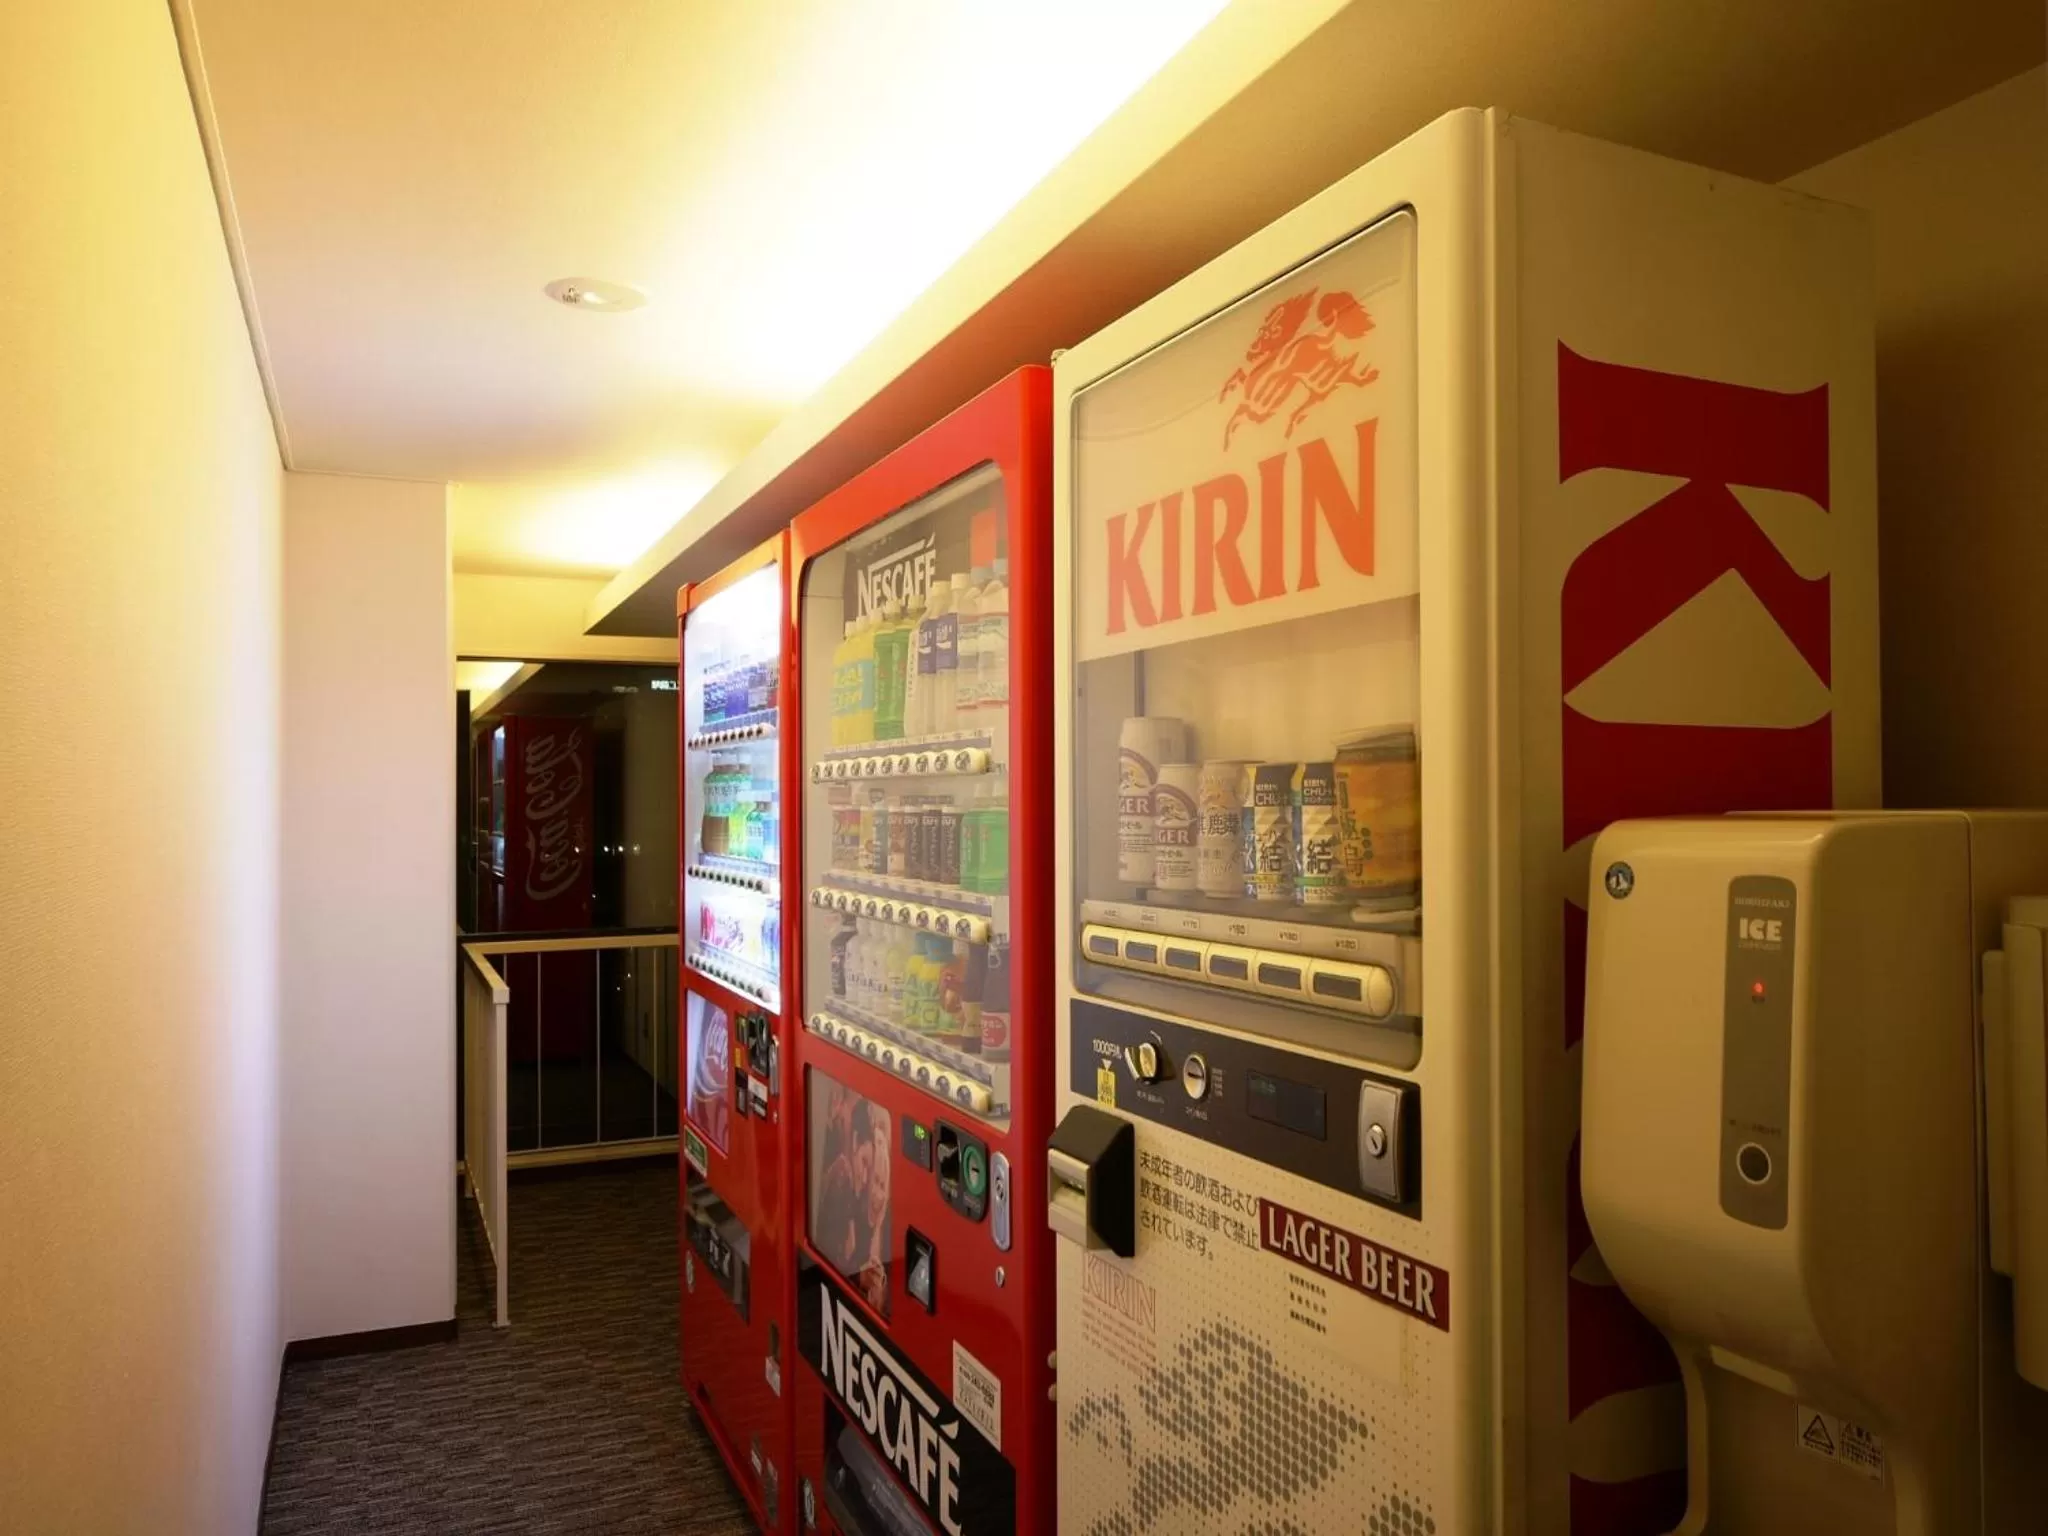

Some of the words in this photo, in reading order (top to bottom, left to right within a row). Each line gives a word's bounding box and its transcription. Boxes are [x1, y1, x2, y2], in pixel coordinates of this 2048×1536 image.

[1105, 417, 1380, 636] KIRIN
[1739, 917, 1782, 942] ICE
[1139, 1151, 1258, 1217] 未成年者の飲酒および
[1139, 1177, 1260, 1251] 飲酒運転は法律で禁止
[1083, 1251, 1156, 1334] KIRIN
[1268, 1206, 1354, 1282] LAGER
[1360, 1244, 1437, 1320] BEER
[820, 1281, 963, 1536] NESCAFÉ
